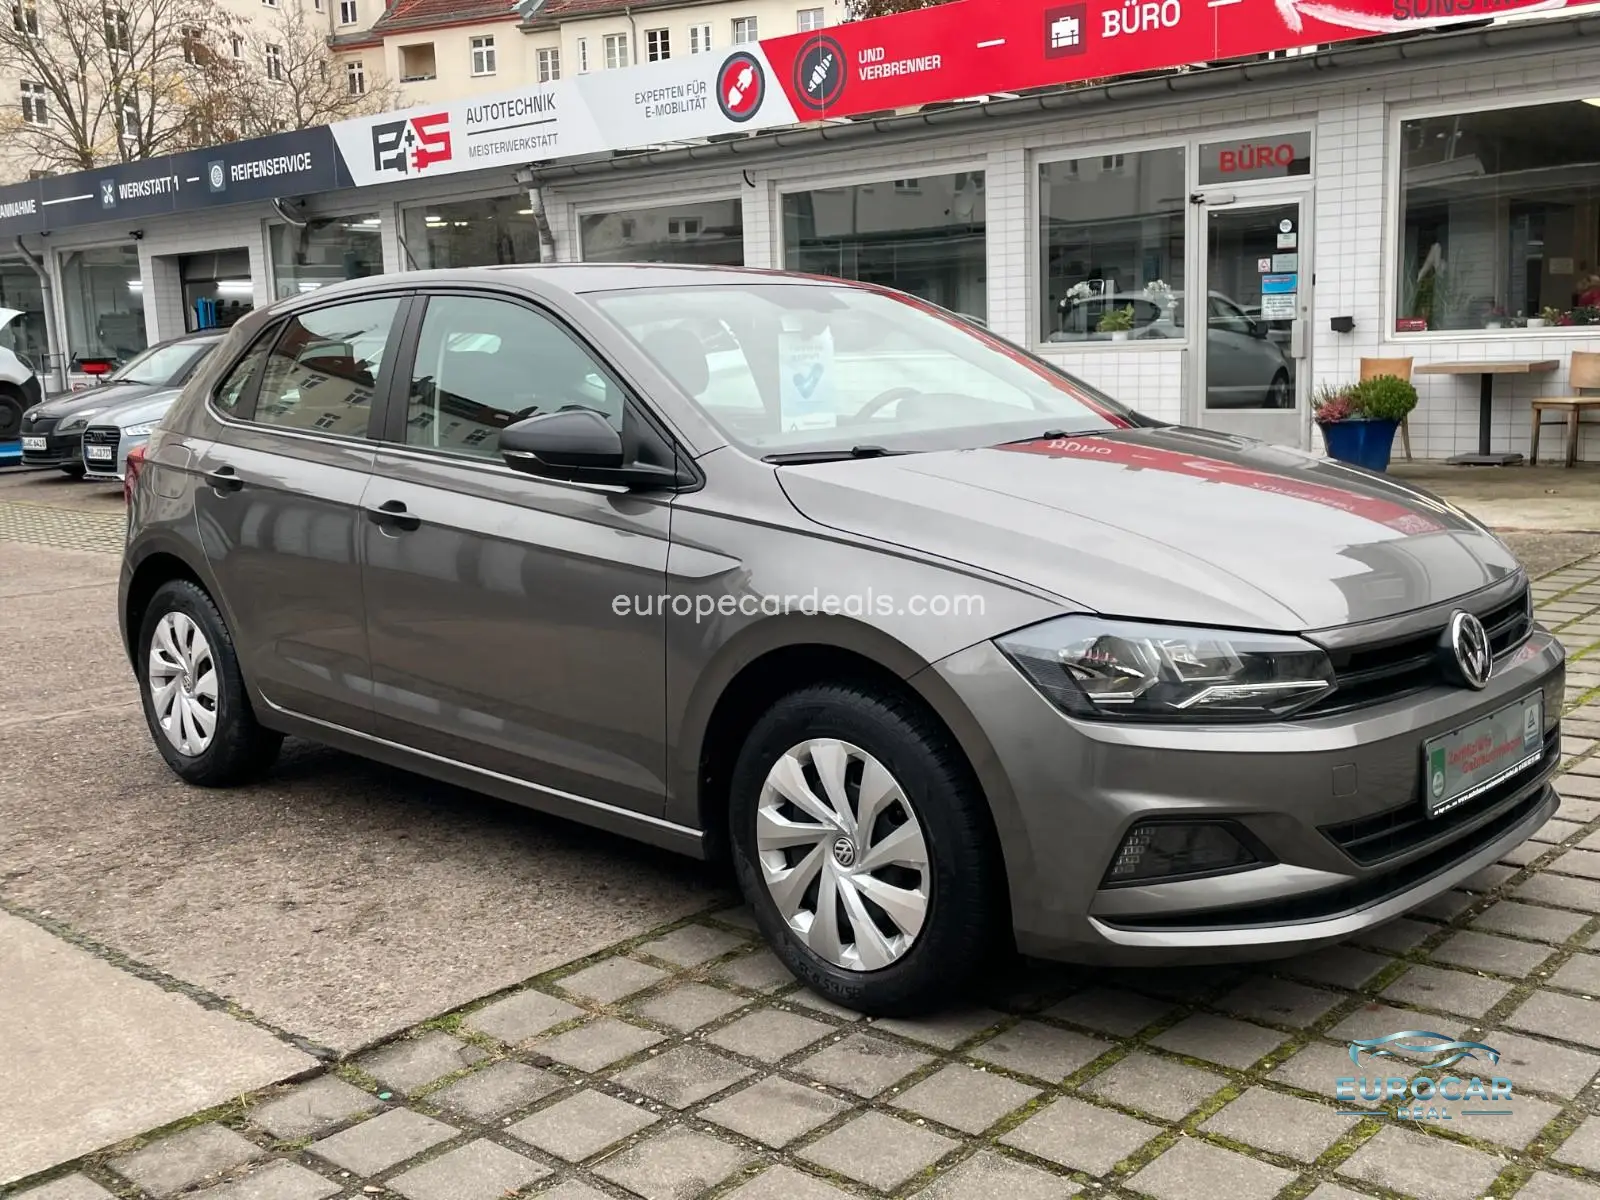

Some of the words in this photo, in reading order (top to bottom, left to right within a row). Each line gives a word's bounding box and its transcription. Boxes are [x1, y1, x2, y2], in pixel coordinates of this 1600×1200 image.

[1101, 0, 1181, 38] BÜRO
[858, 47, 885, 64] UND
[858, 54, 941, 81] VERBRENNER
[635, 86, 685, 105] EXPERTEN
[686, 81, 707, 99] FÜR
[466, 92, 556, 125] AUTOTECHNIK
[645, 96, 707, 119] E-MOBILITÄT
[468, 133, 559, 158] MEISTERWERKSTATT
[1218, 143, 1295, 173] BÜRO
[230, 152, 312, 182] REIFENSERVICE
[118, 178, 172, 200] WERKSTATT
[173, 176, 180, 191] 1
